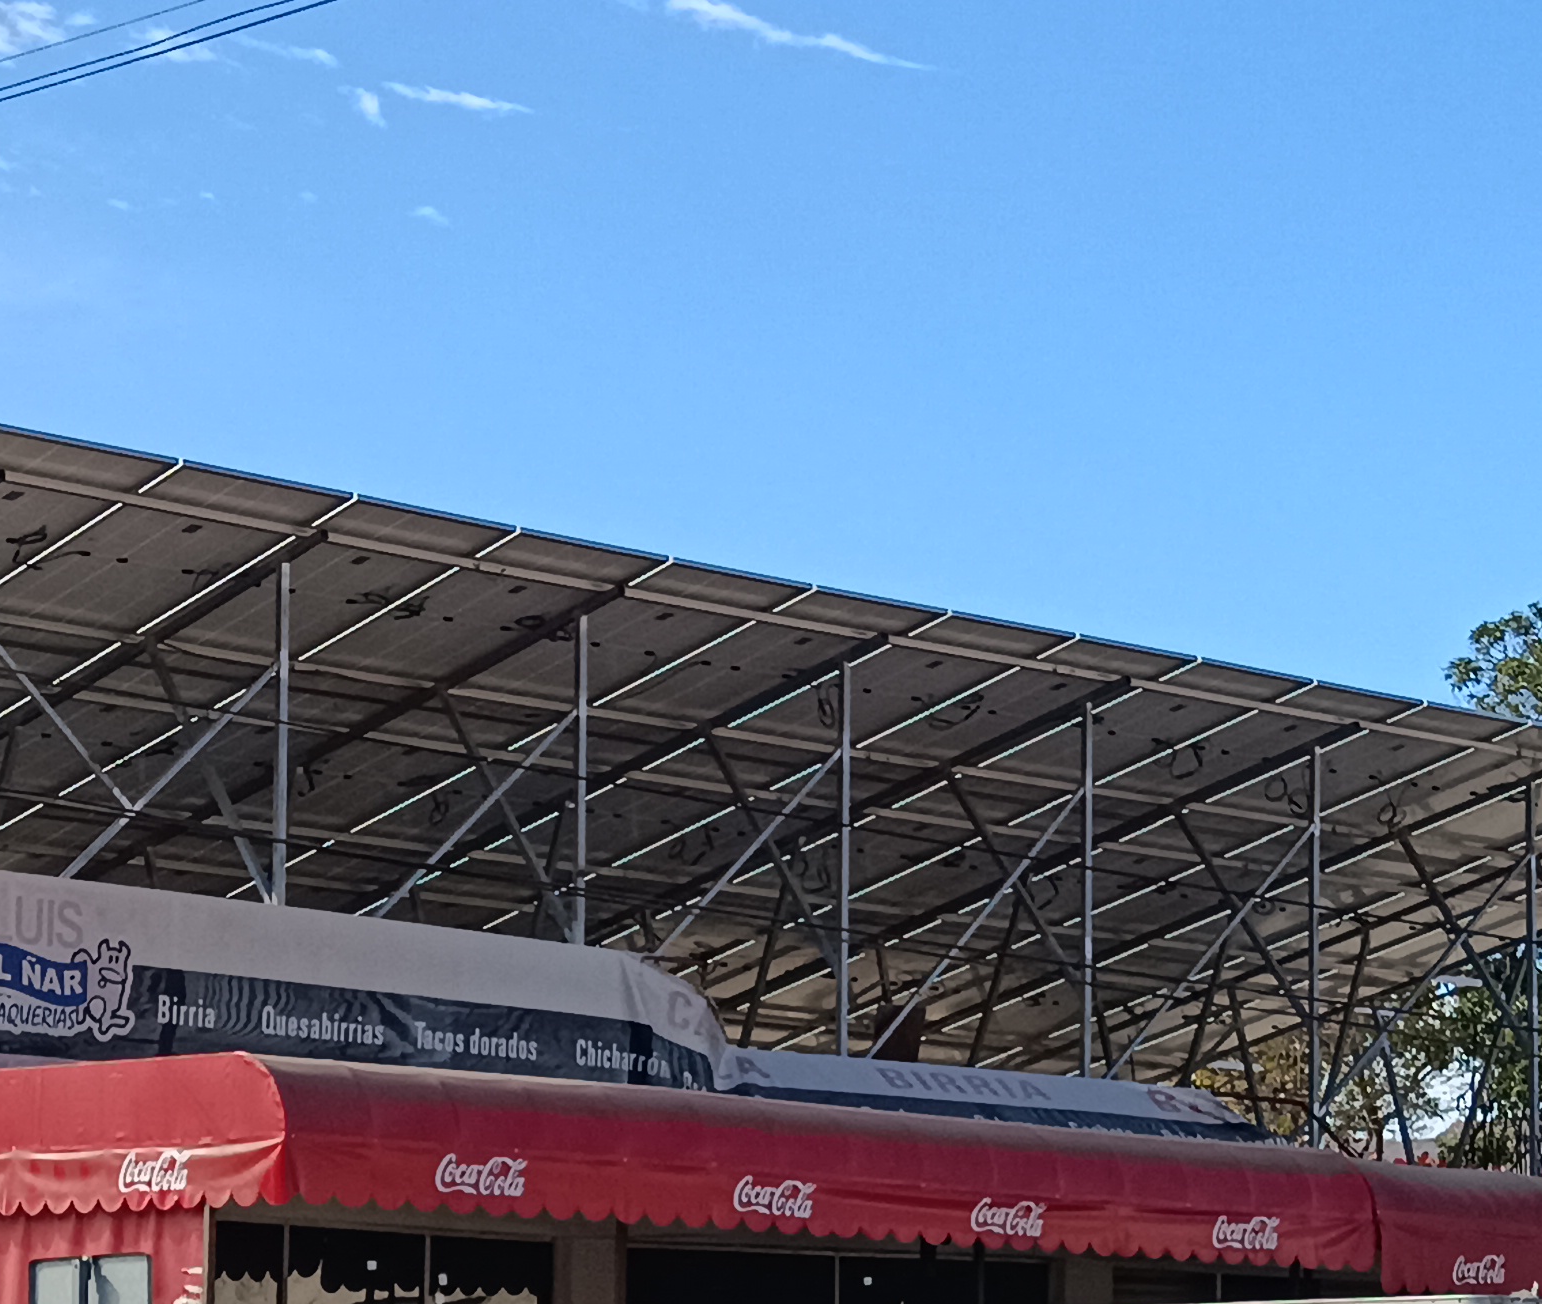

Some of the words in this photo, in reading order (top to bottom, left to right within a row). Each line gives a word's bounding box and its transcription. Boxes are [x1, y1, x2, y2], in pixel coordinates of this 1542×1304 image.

[21, 955, 83, 996] ÑAR
[158, 994, 216, 1030] Birria
[261, 1005, 385, 1046] Quesabirrias
[414, 1020, 465, 1054] Tacos
[469, 1027, 538, 1062] dorados
[575, 1038, 672, 1080] Chicharrón
[875, 1066, 1052, 1101] BIRRIA
